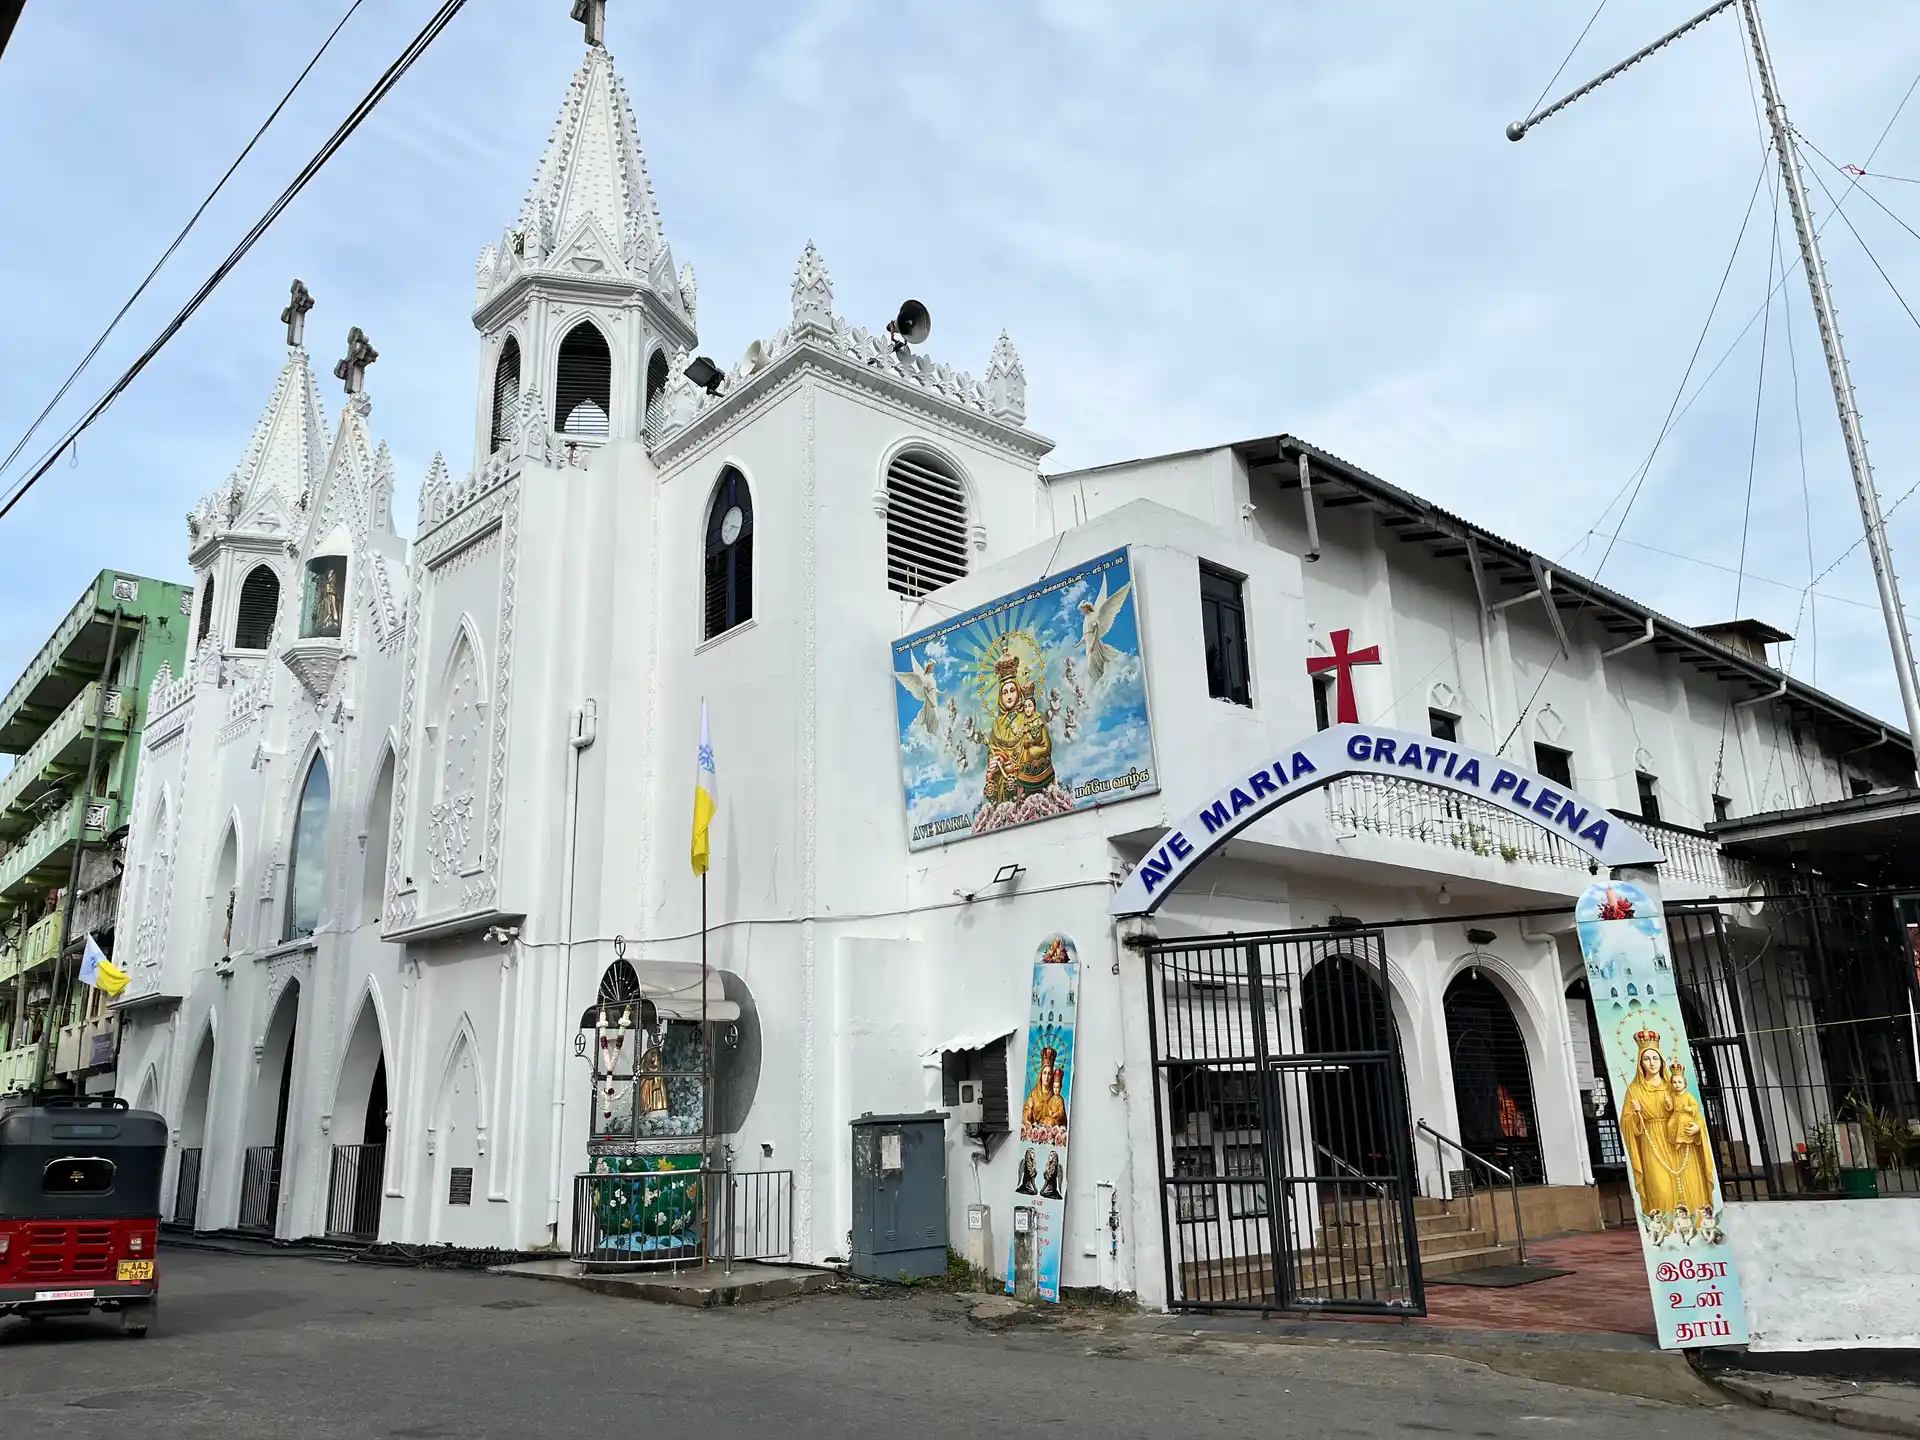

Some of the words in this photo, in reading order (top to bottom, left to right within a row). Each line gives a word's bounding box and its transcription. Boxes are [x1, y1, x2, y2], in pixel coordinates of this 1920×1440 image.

[1075, 778, 1110, 799] மரியே
[1111, 766, 1150, 791] வாழ்க
[913, 823, 934, 841] AVE
[935, 813, 971, 836] MARIA
[1140, 831, 1194, 893] AVE
[1199, 751, 1316, 834] MARIA
[1347, 734, 1480, 787] GRATIA
[1490, 769, 1610, 850] PLENA
[1656, 1258, 1729, 1283] இதோ
[1669, 1284, 1724, 1310] உன்
[1675, 1313, 1732, 1344] தாய்
